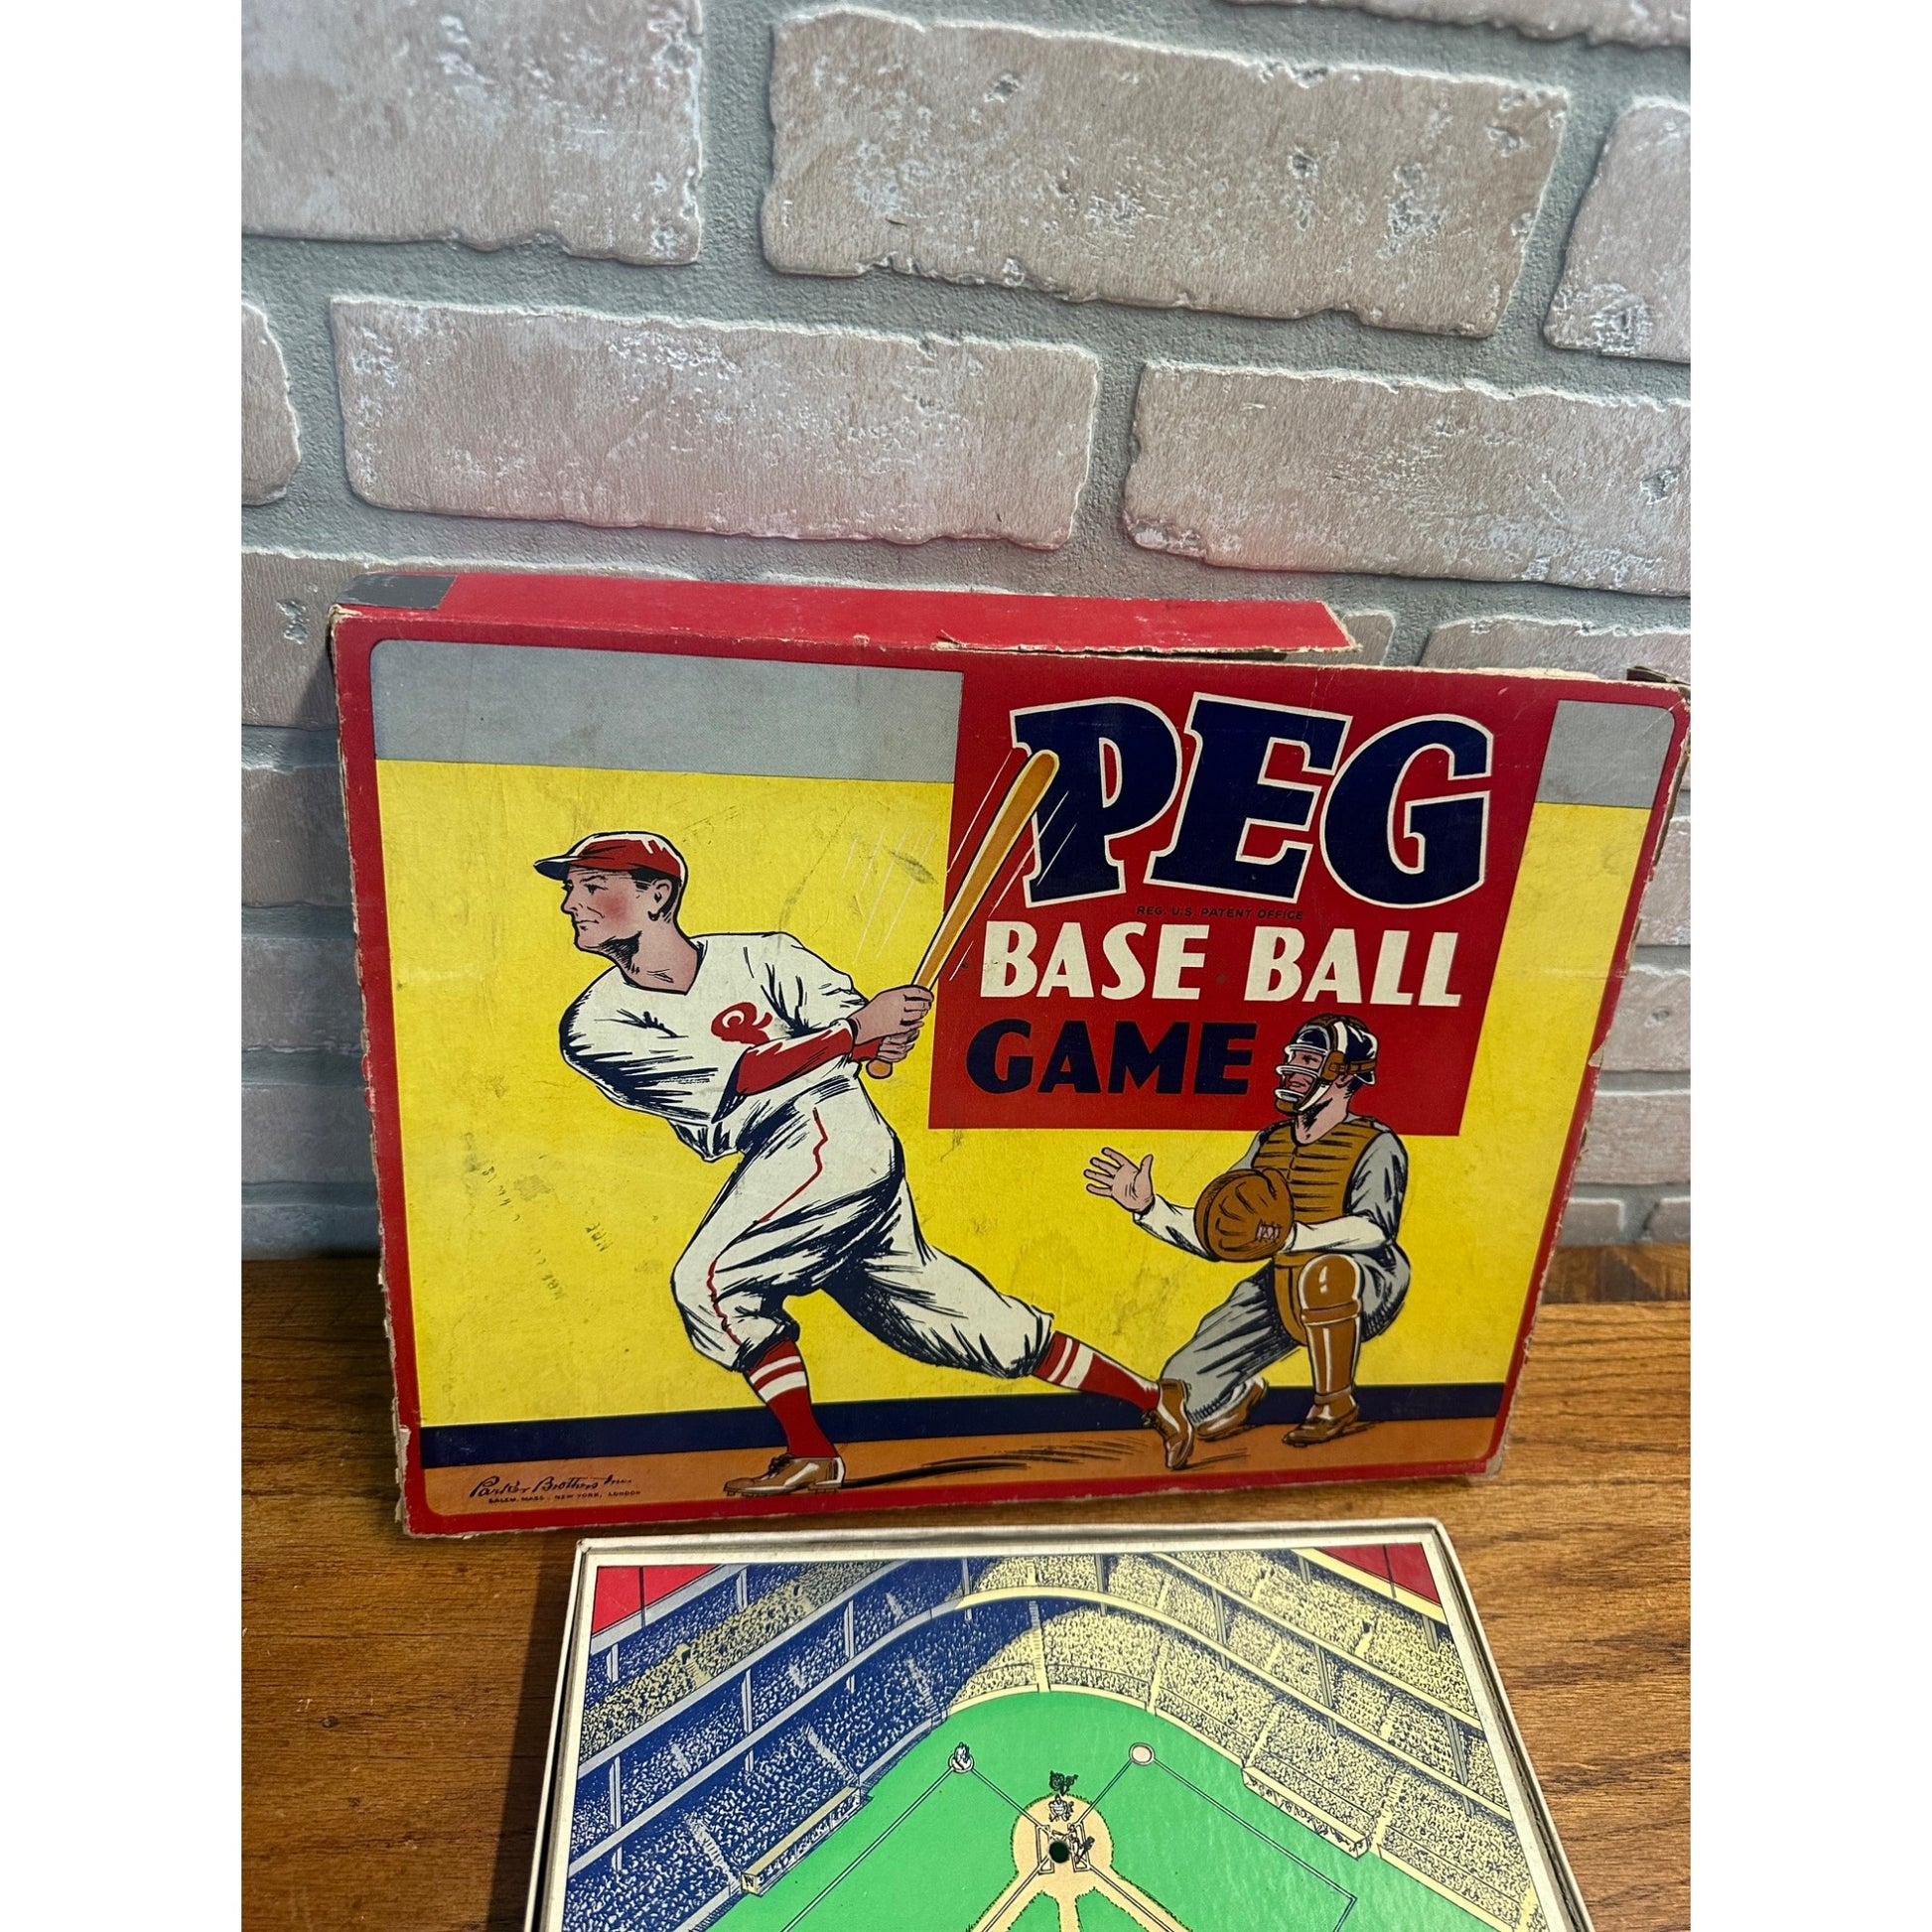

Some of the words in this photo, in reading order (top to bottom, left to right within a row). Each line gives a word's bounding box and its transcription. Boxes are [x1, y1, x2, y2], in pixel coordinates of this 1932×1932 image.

[1010, 691, 1494, 908] PEG
[1136, 905, 1167, 916] REG.
[1172, 906, 1197, 916] U.S.
[1200, 907, 1253, 918] PATENT
[1257, 908, 1304, 920] OFFICE
[980, 921, 1210, 1000] BASE
[1243, 925, 1462, 1008] BALL
[966, 1018, 1257, 1096] GAME
[470, 1475, 530, 1498] Parker
[532, 1475, 599, 1493] Brothers
